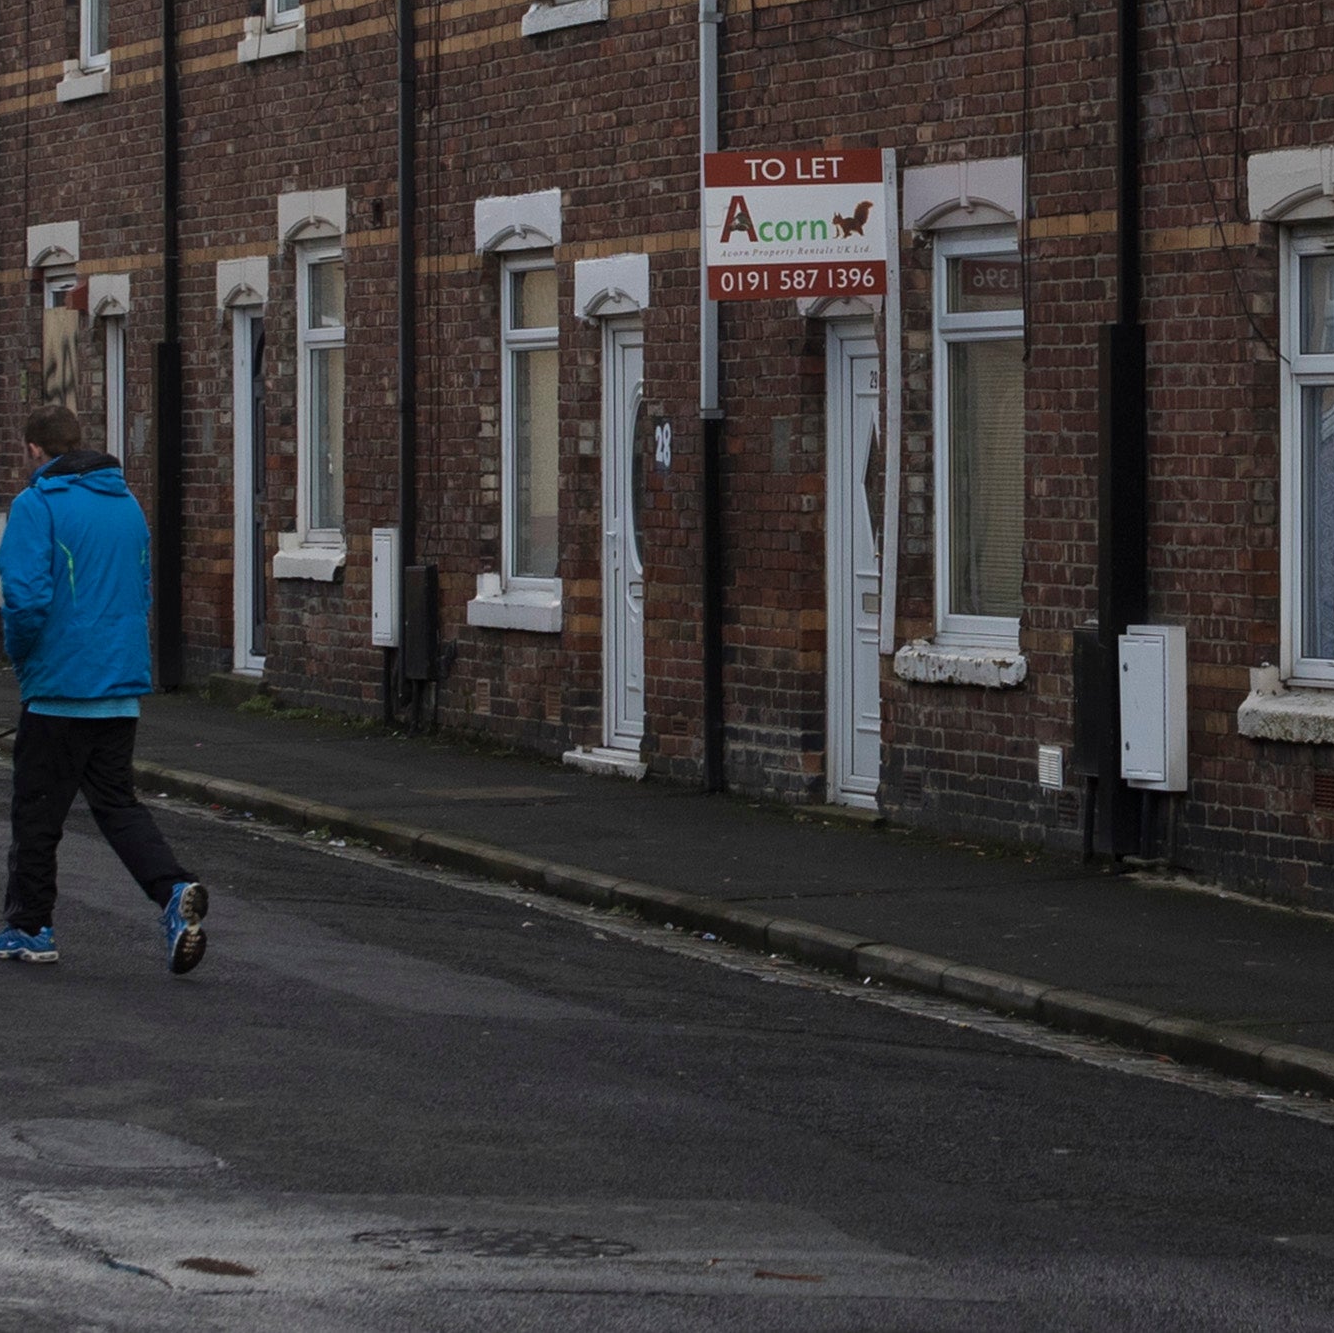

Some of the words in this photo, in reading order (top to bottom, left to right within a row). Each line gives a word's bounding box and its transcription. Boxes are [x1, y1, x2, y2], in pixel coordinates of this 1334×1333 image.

[744, 158, 786, 181] TO
[796, 157, 844, 179] LET
[720, 195, 828, 243] Acorn
[720, 249, 749, 258] Acorn
[752, 248, 794, 259] Property
[797, 246, 833, 255] Rentals
[836, 245, 850, 254] UK
[720, 271, 769, 292] 0191
[779, 269, 819, 290] 587
[828, 268, 875, 288] 1396
[655, 422, 671, 467] 28
